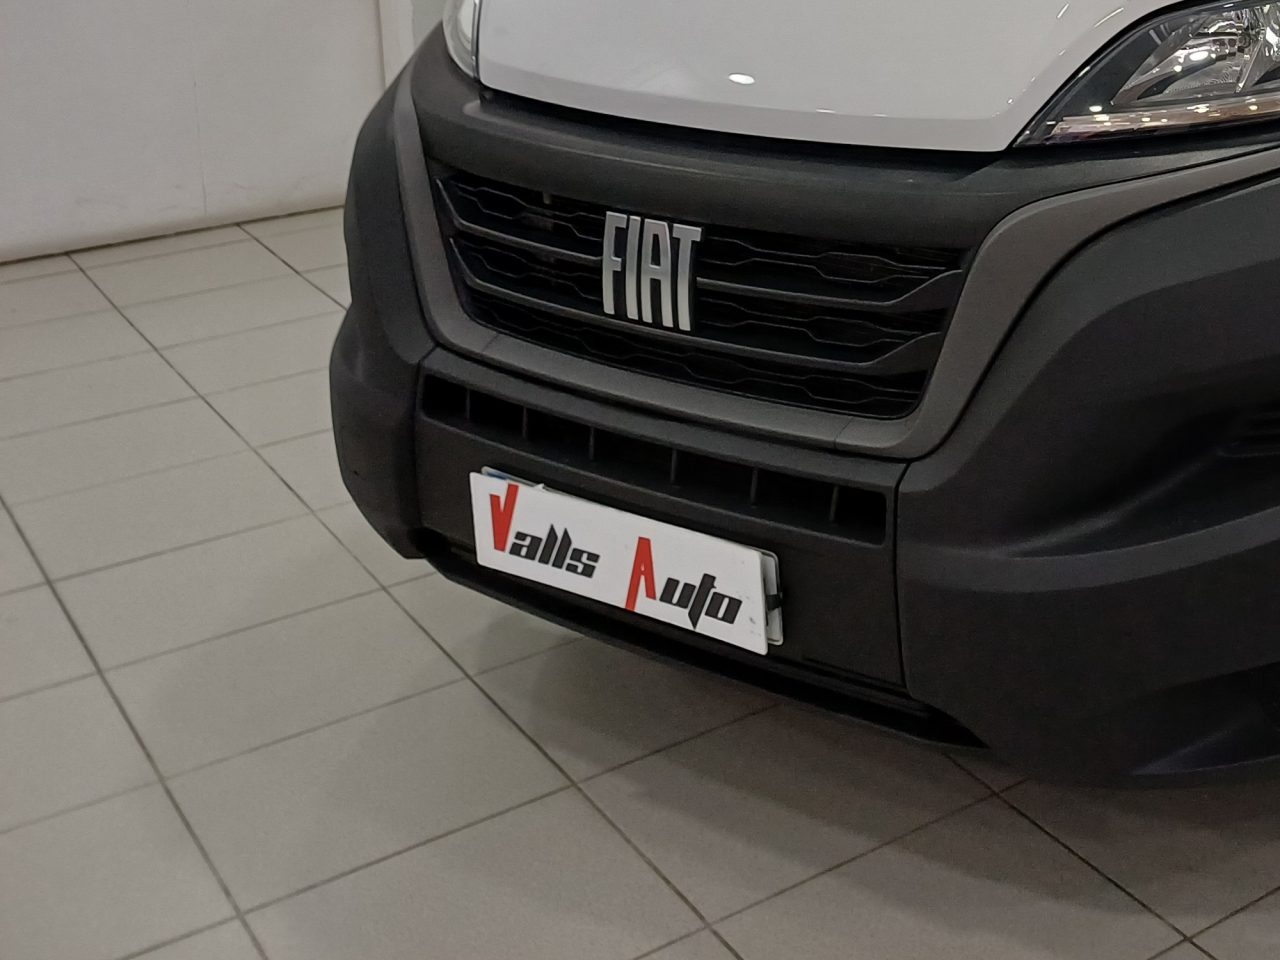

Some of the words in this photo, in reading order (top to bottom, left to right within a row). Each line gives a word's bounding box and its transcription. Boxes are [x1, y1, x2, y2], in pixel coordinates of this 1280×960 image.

[602, 210, 702, 331] FIAT
[489, 483, 600, 578] Valls
[625, 537, 743, 630] Auto
